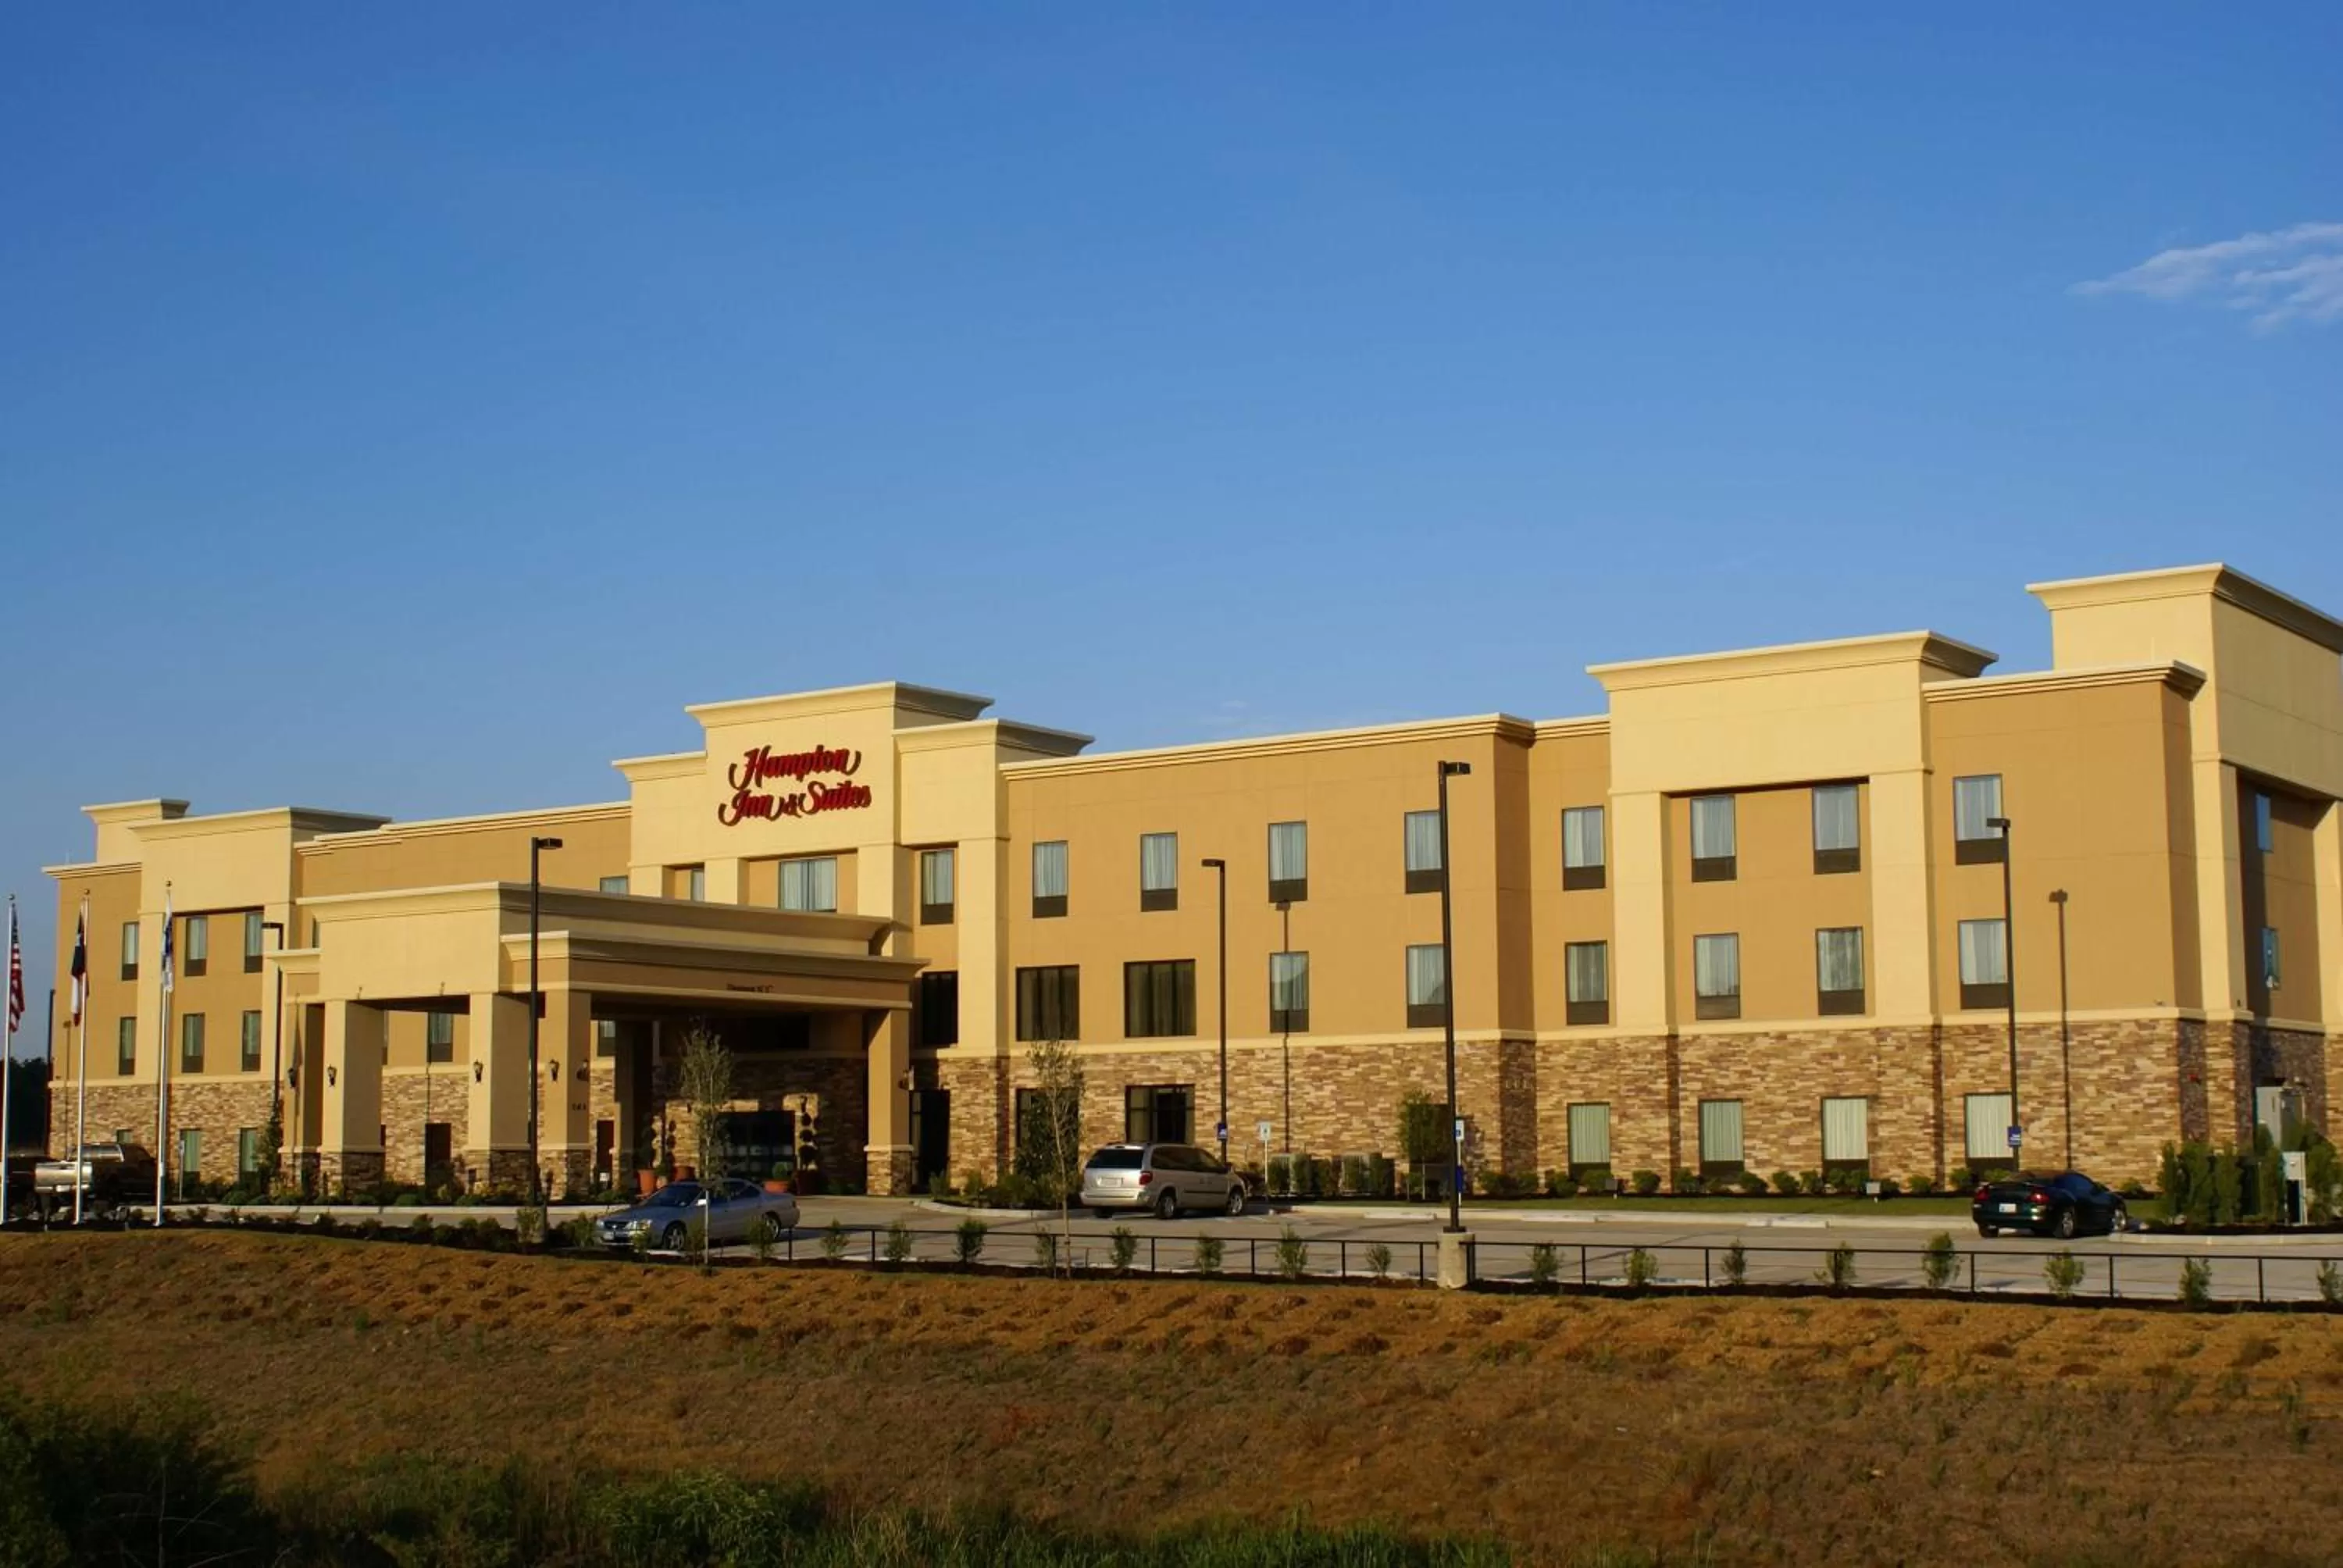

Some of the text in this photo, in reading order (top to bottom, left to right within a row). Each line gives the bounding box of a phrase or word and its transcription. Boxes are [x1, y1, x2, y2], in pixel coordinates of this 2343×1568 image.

[729, 744, 861, 790] Hampton
[718, 789, 783, 826] Inn
[798, 781, 872, 814] Suites
